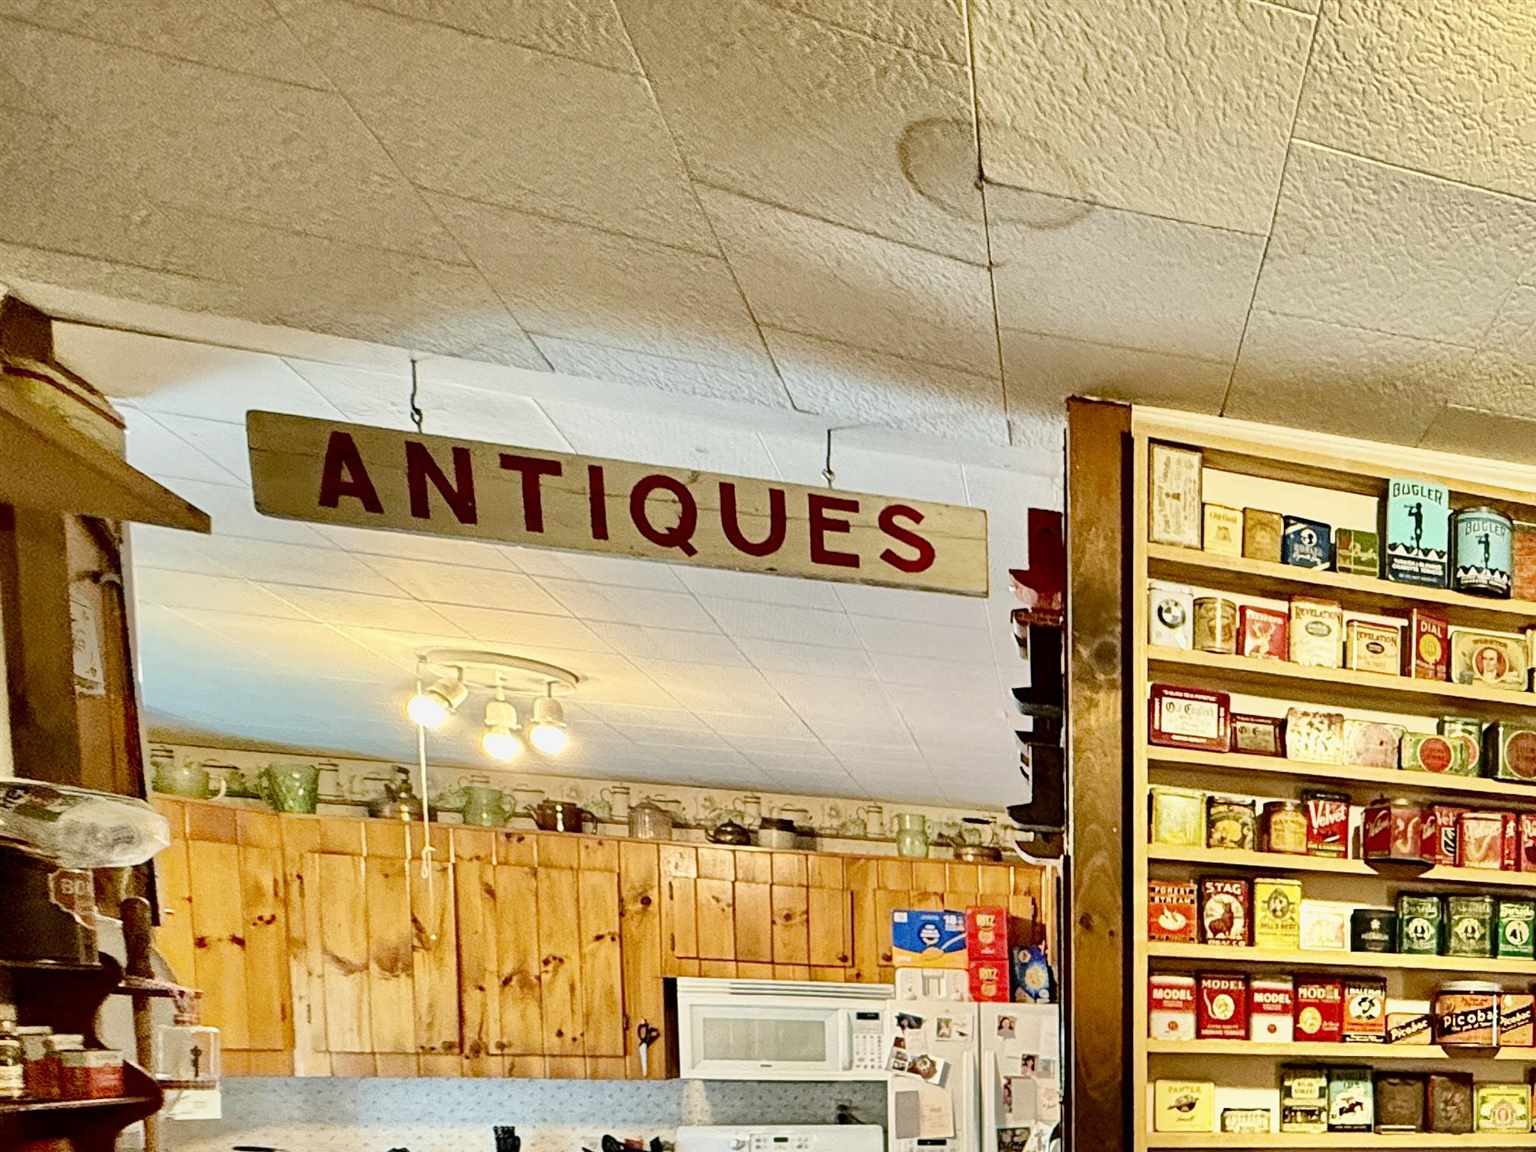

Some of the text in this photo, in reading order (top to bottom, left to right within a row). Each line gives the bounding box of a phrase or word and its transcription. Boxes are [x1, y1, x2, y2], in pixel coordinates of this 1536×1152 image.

[318, 431, 937, 575] ANTIQUES
[1392, 482, 1443, 506] BUGLER
[1464, 520, 1507, 538] BUGLER
[1295, 606, 1343, 628] REVELATION
[1420, 620, 1443, 638] DIAL
[1306, 800, 1348, 830] Velvet
[1205, 881, 1242, 895] STAG
[1201, 979, 1246, 990] MODEL
[1298, 984, 1341, 1000] MODEL
[1152, 988, 1193, 1001] MODEL
[1253, 992, 1292, 1004] MODEL
